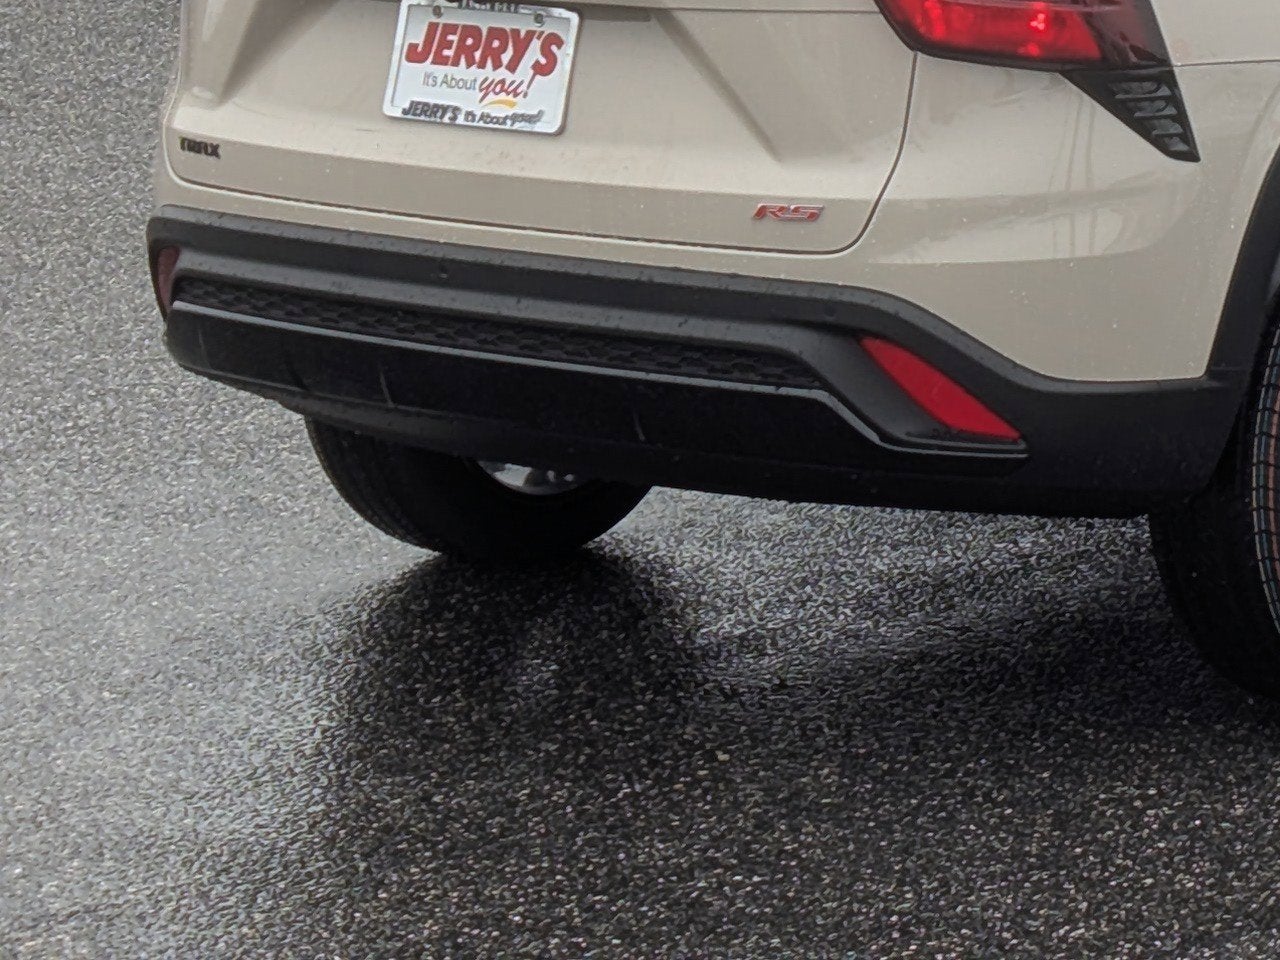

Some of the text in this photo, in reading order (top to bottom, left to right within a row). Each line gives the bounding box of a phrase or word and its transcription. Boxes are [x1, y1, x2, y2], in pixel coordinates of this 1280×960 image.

[405, 21, 565, 77] JERRY'S
[422, 70, 537, 103] It's About you!
[401, 100, 462, 123] JERRY'S
[752, 202, 825, 222] RS
